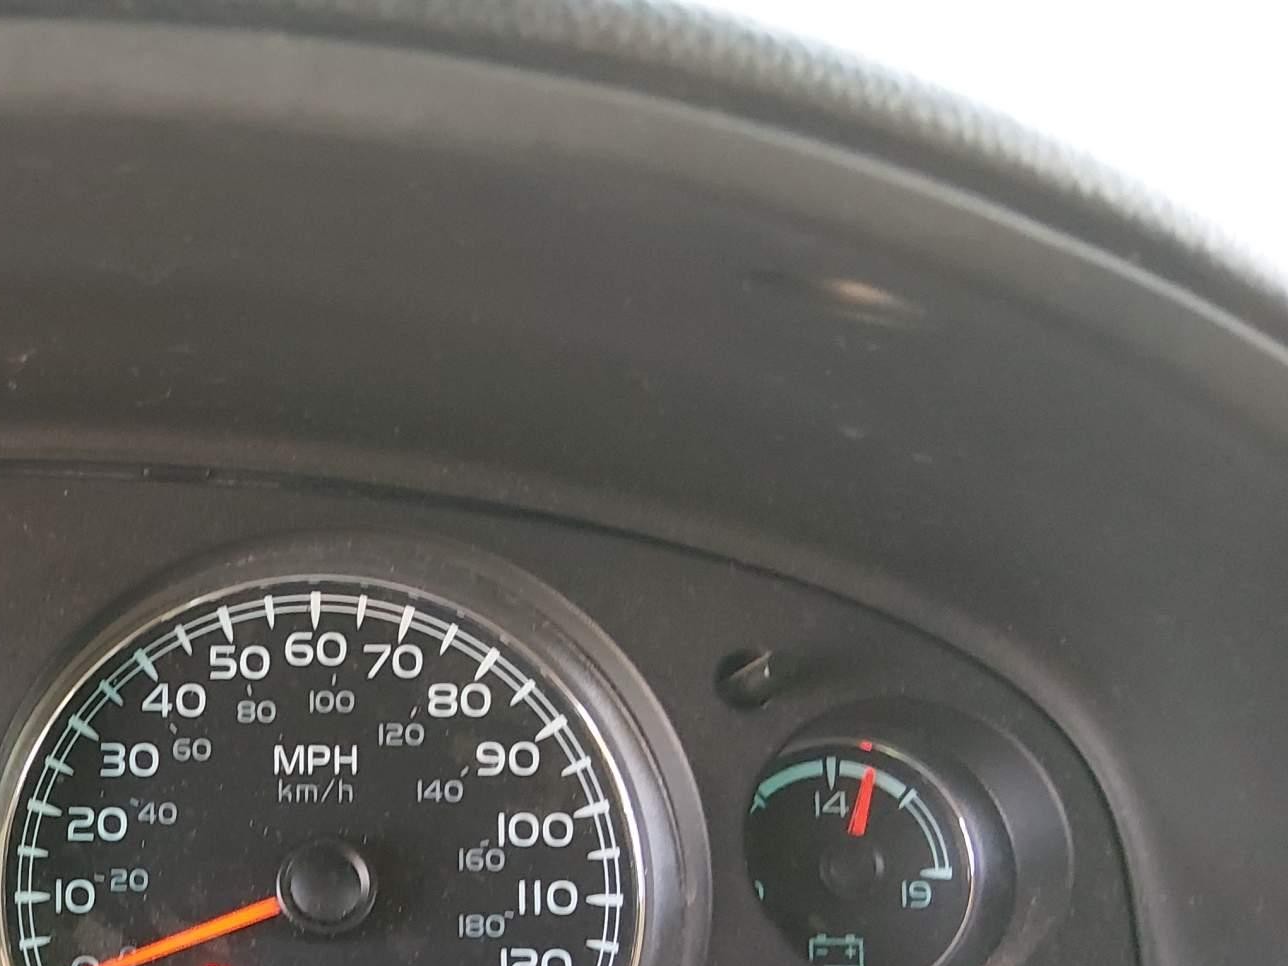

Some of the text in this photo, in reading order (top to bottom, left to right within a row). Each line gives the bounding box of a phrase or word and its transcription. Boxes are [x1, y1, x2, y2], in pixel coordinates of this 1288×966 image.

[209, 645, 270, 680] 50
[285, 632, 348, 667] 60
[363, 644, 423, 679] 70
[142, 683, 206, 718] 40
[237, 700, 276, 724] 80
[309, 689, 355, 714] 100
[427, 682, 492, 718] 80
[378, 722, 425, 746] 120
[100, 742, 160, 777] 30
[172, 738, 212, 762] 60
[274, 744, 358, 775] MPH
[476, 741, 540, 777] 90
[278, 778, 354, 804] km/h
[417, 779, 464, 803] 140
[815, 790, 850, 818] 14
[67, 806, 128, 842] 20
[137, 801, 178, 825] 40
[498, 812, 574, 848] 100
[458, 847, 506, 872] 160
[110, 868, 149, 892] 20
[902, 880, 933, 909] 19
[55, 879, 96, 913] 10
[518, 879, 579, 916] 110
[458, 913, 505, 938] 180
